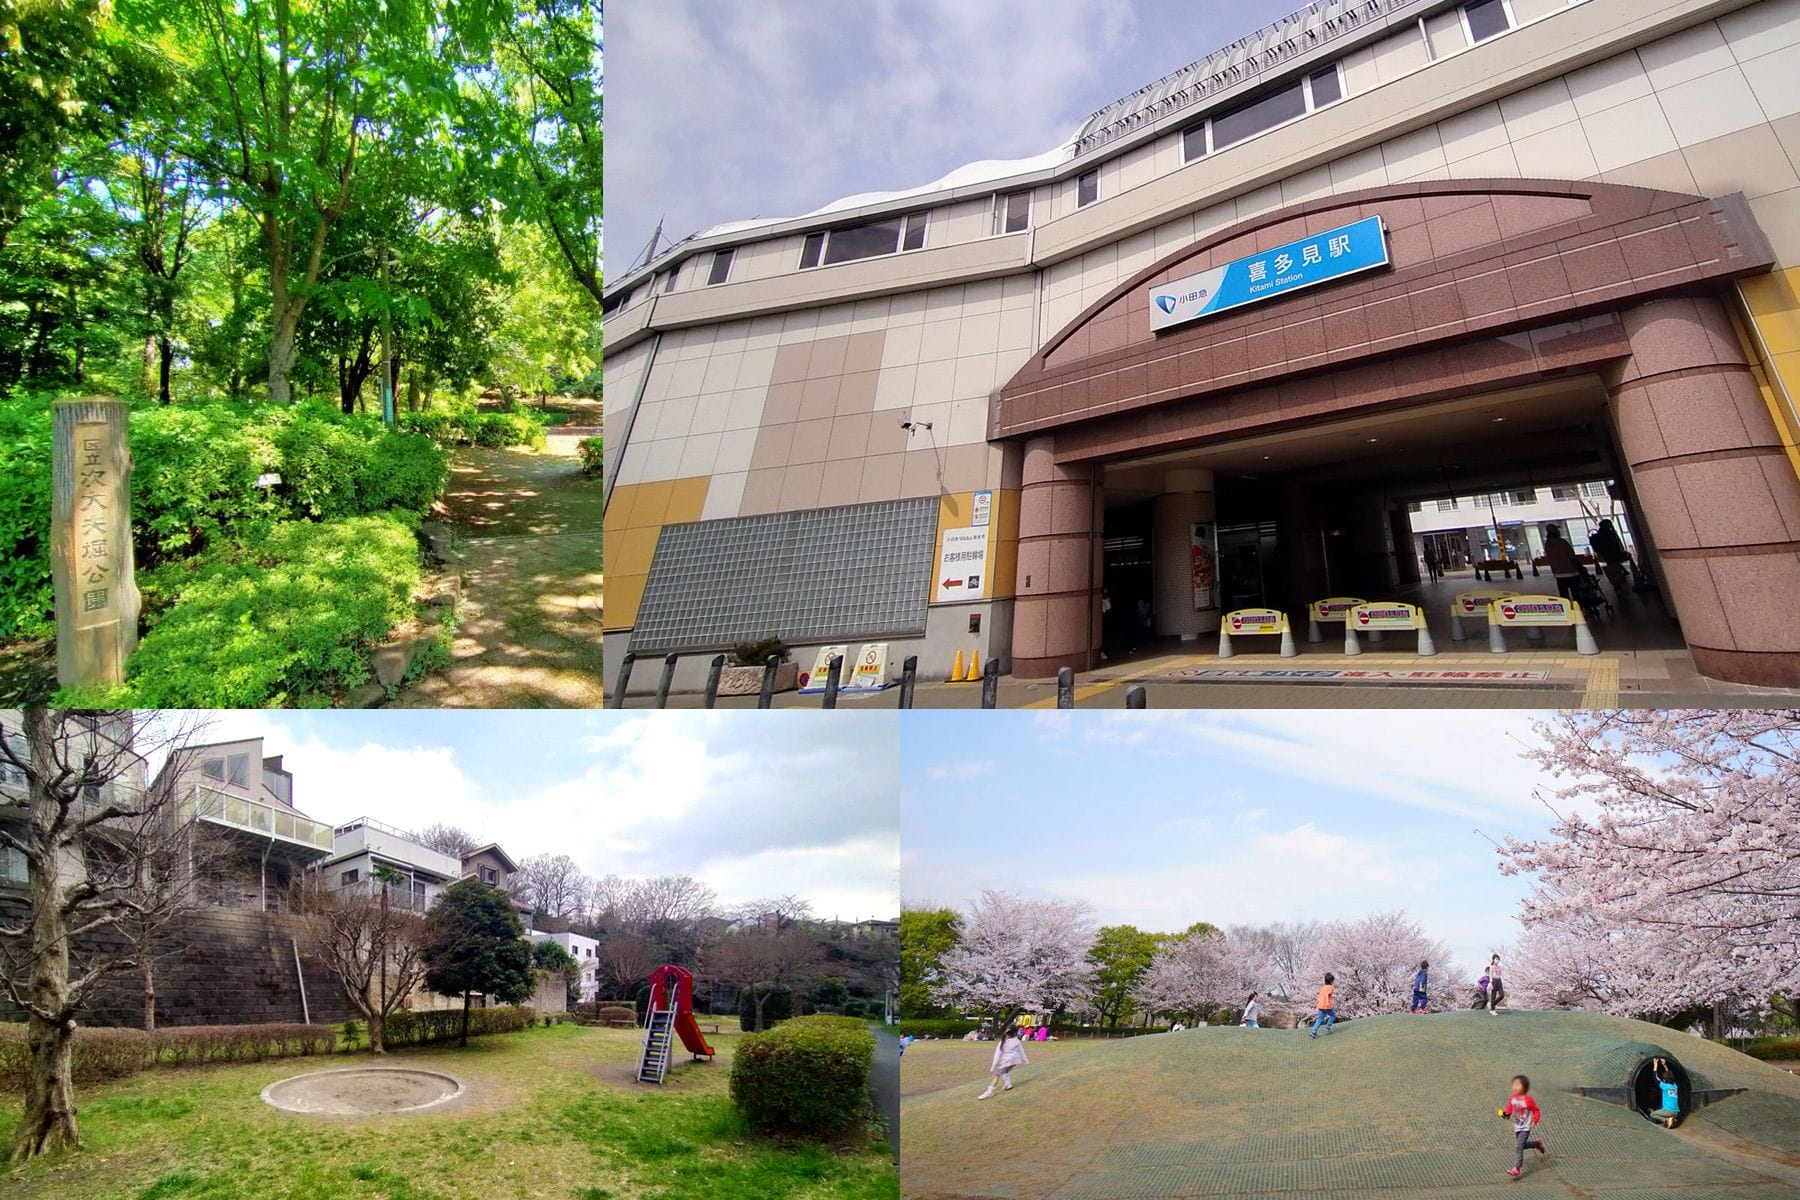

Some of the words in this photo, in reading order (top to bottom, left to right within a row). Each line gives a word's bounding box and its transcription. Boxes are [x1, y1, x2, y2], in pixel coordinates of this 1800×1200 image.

[1248, 234, 1352, 282] 喜多見駅
[1249, 281, 1274, 295] Kitami
[1275, 272, 1304, 287] Station
[1179, 289, 1208, 304] 小田急
